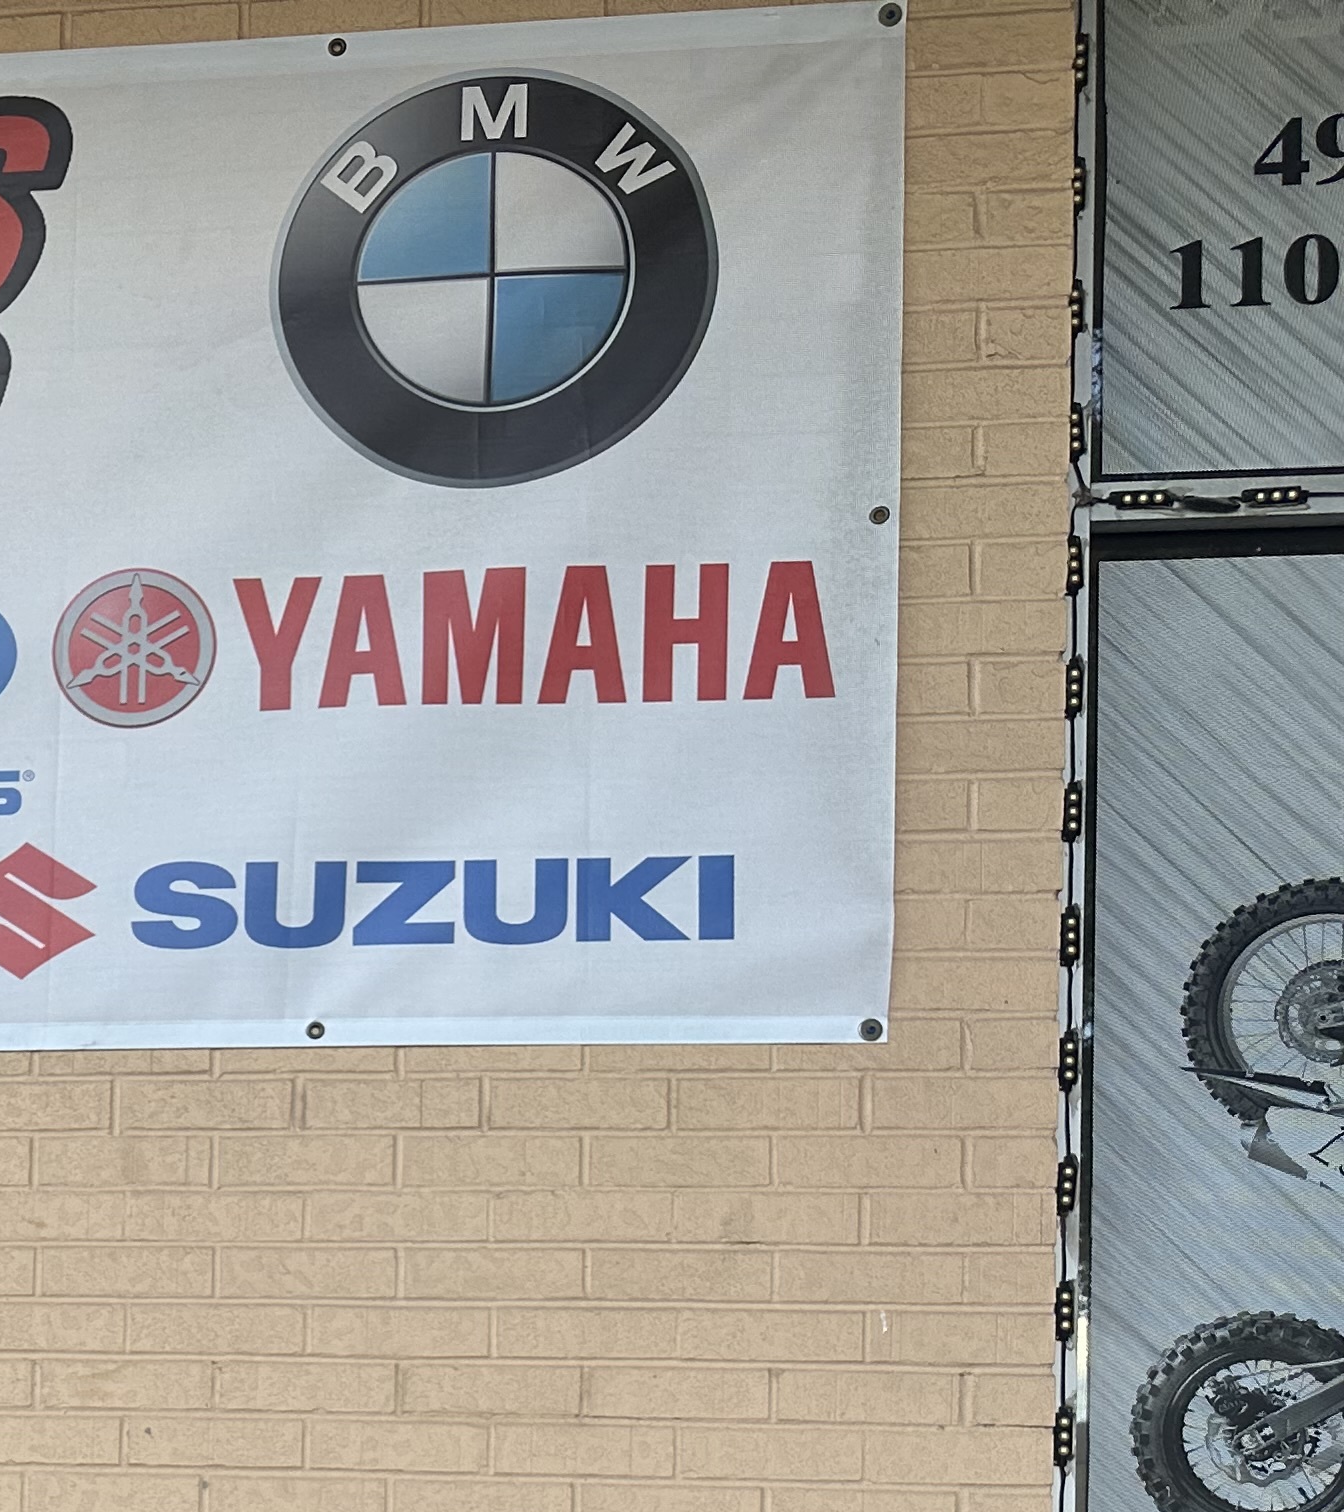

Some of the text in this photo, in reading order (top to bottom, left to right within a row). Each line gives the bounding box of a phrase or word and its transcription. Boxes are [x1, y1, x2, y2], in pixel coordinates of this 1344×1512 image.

[320, 83, 676, 213] BMW
[1169, 233, 1340, 310] 110
[232, 560, 837, 712] YAMAHA
[130, 854, 736, 950] SUZUKI
